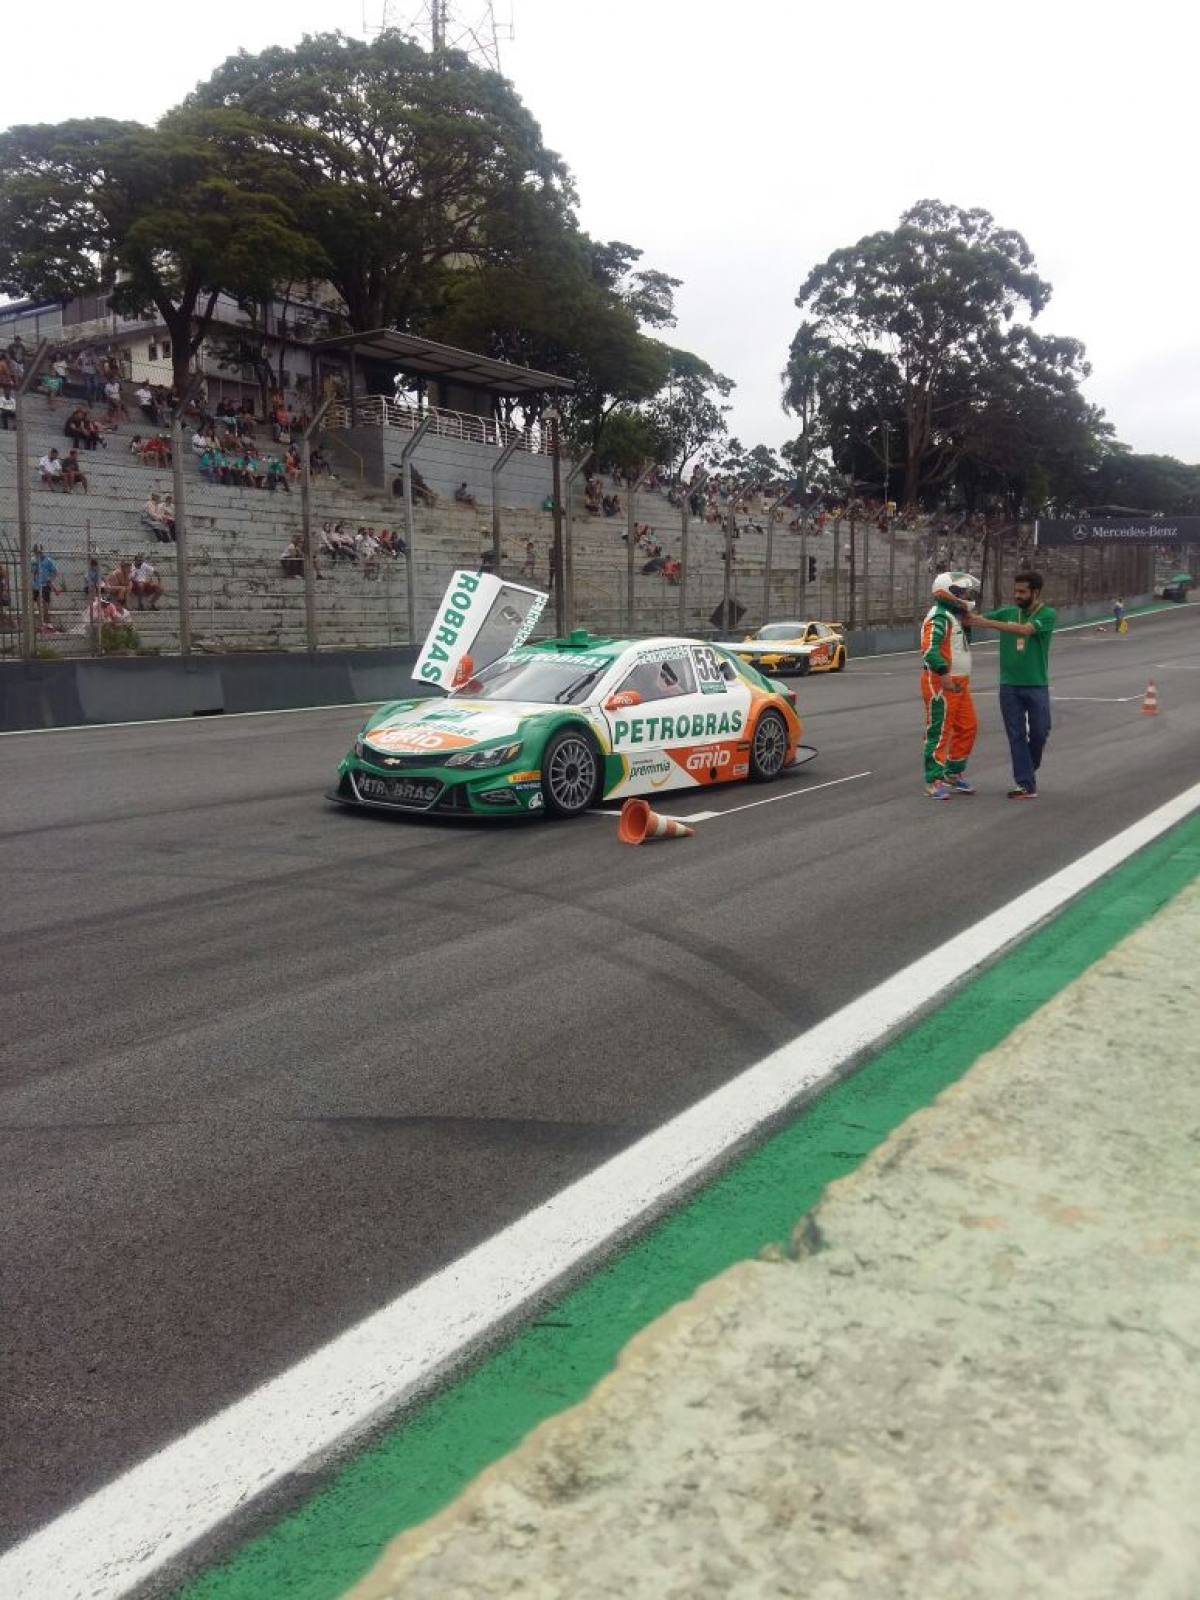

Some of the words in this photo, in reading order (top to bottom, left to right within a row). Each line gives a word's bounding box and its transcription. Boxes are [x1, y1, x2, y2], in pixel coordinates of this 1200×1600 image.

[1092, 526, 1178, 537] Mercedes-Benz
[692, 647, 720, 680] 53
[614, 710, 742, 745] PETROBRAS
[380, 731, 443, 748] GRID
[686, 750, 731, 770] GRID
[629, 761, 671, 780] premmia
[357, 773, 436, 800] PETRBRAS
